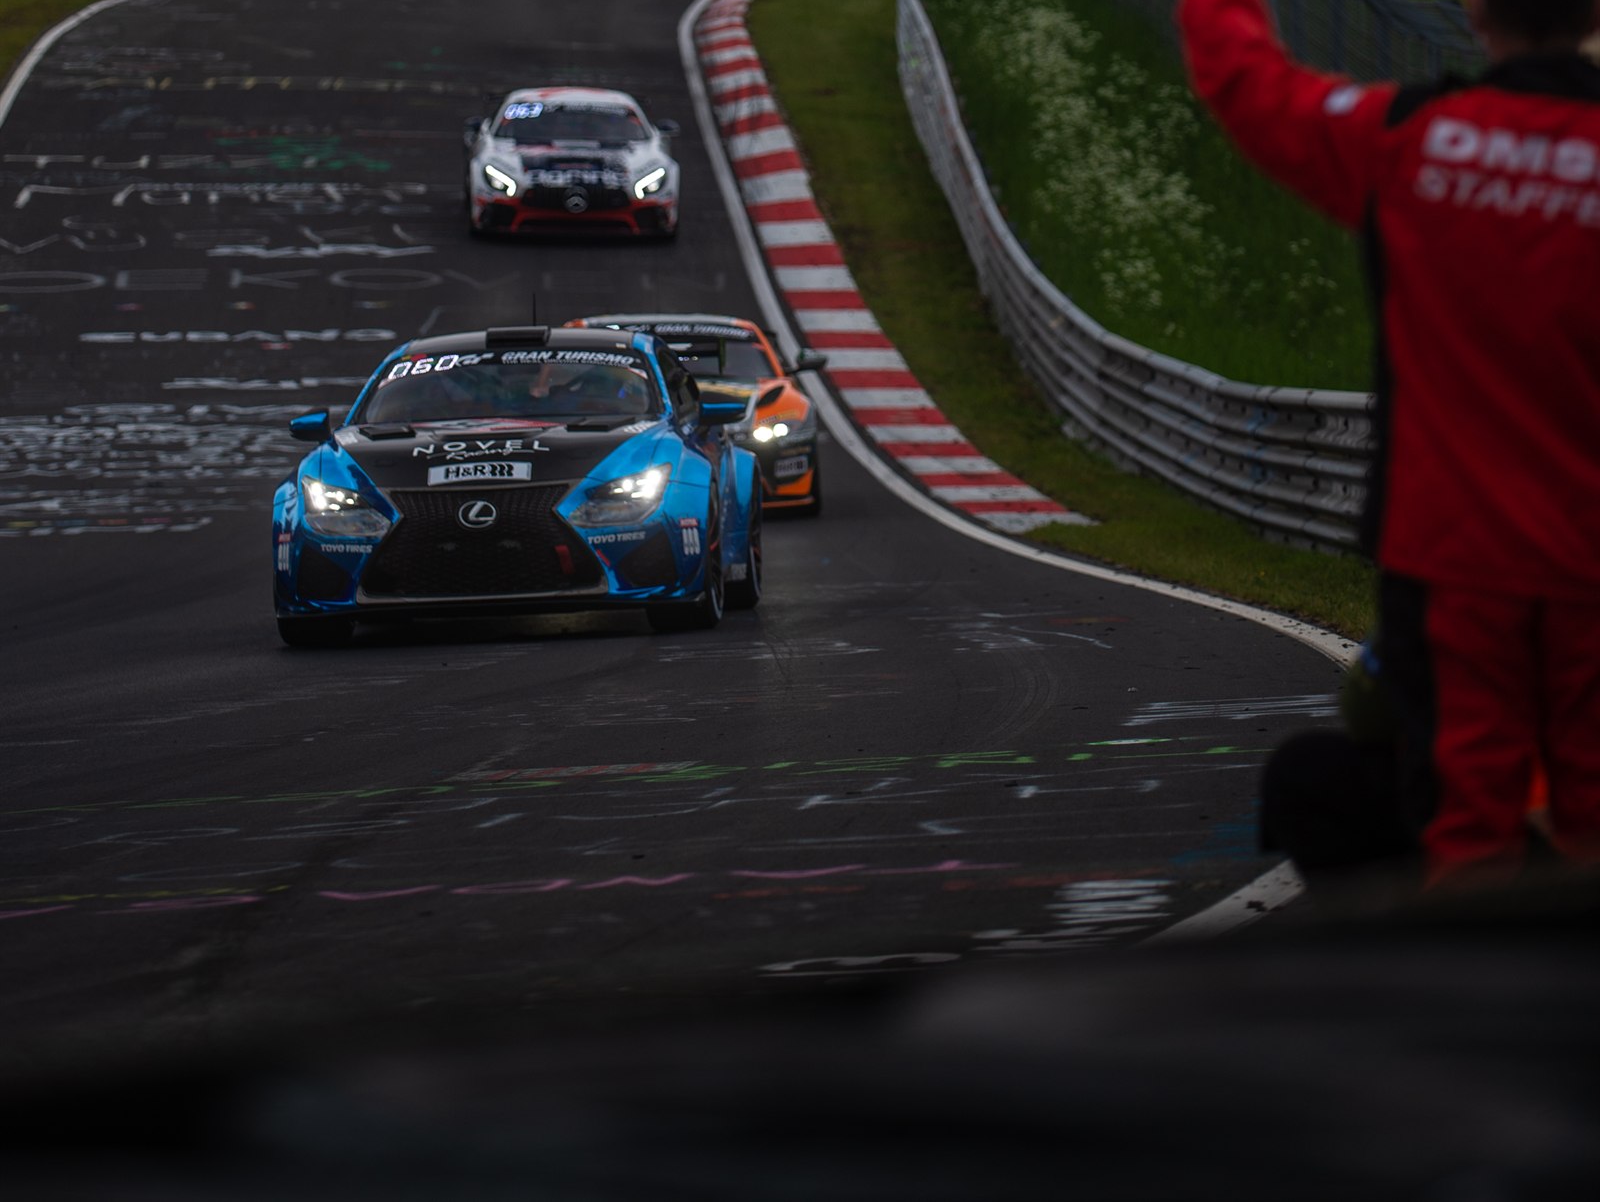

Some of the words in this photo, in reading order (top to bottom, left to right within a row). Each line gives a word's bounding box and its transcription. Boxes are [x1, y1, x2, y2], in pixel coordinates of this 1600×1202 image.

[1421, 114, 1600, 184] DMS
[387, 354, 459, 380] 060
[501, 350, 553, 361] GRAN
[554, 350, 634, 365] TURISMO
[412, 439, 550, 457] NOVEL
[445, 464, 487, 479] H&R
[588, 533, 616, 544] TOYO
[617, 530, 646, 542] TIRES
[320, 543, 346, 553] TOYO
